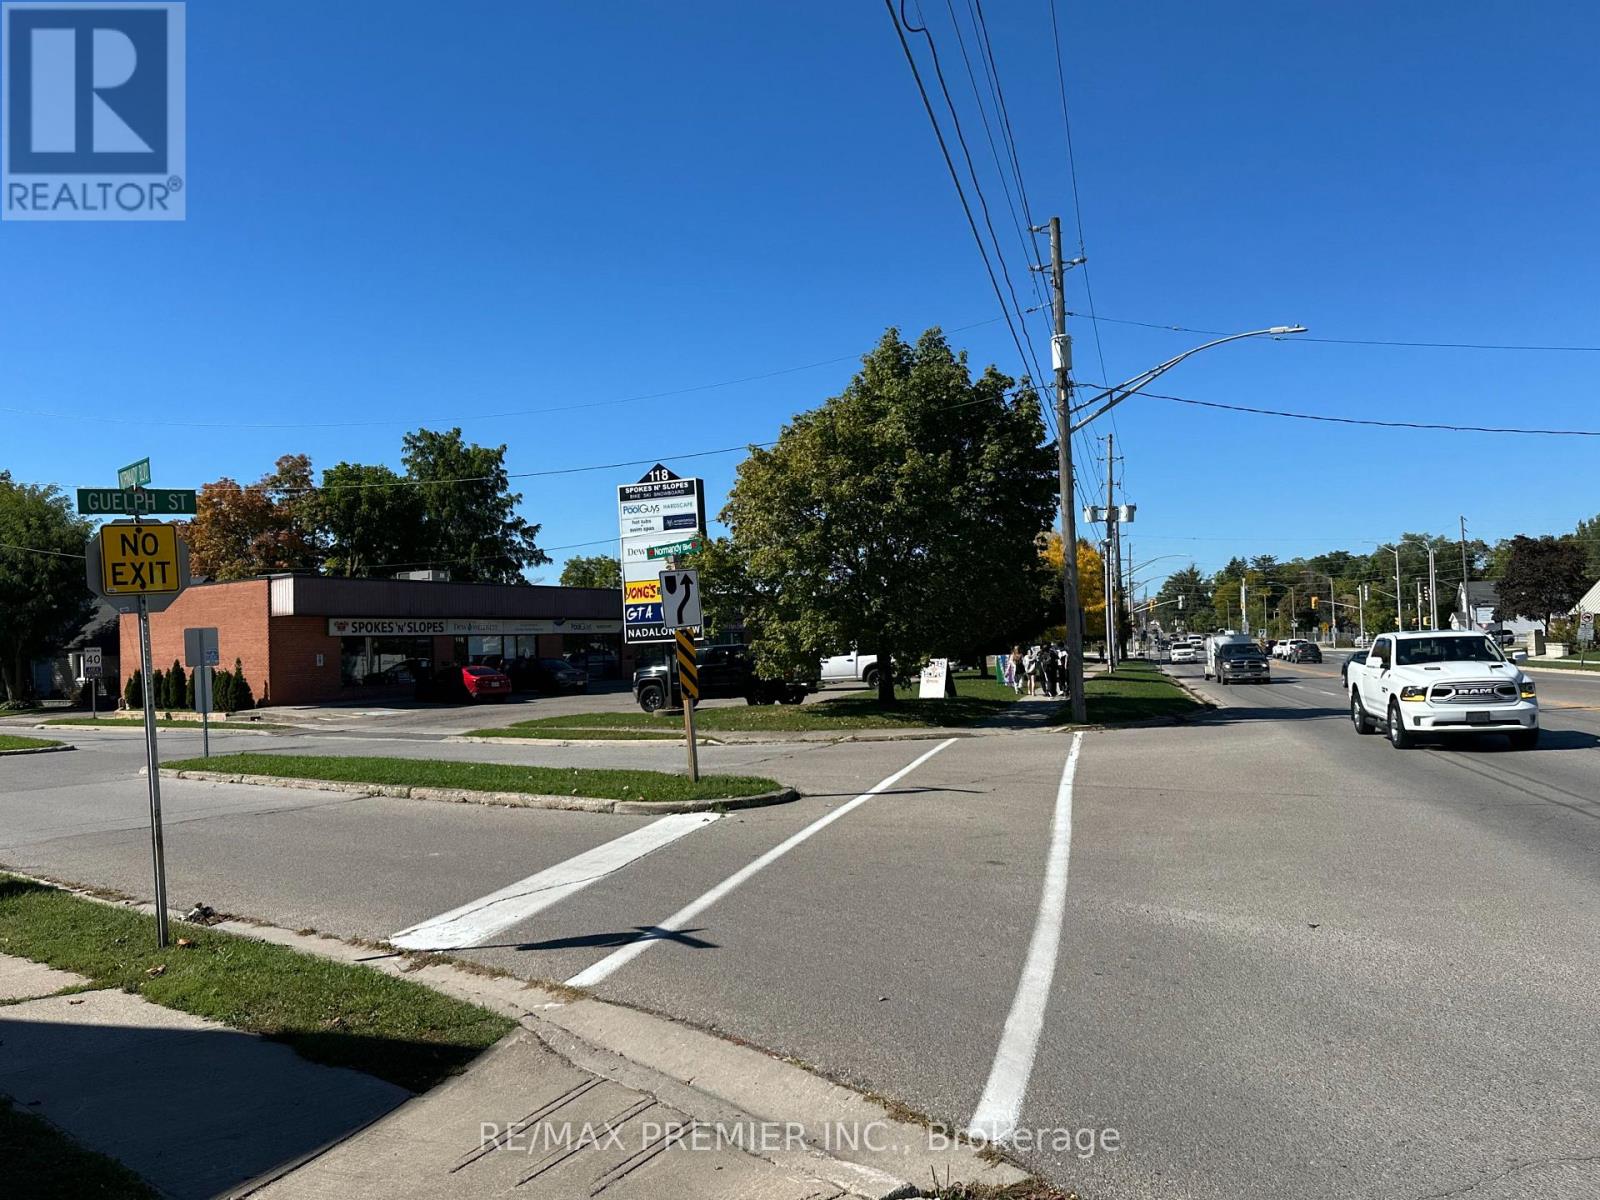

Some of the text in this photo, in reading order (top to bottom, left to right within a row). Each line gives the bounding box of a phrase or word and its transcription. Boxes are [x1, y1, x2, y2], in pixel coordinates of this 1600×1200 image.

[649, 469, 669, 482] 118
[625, 485, 653, 494] SPOKES
[662, 481, 689, 490] SLOPES
[653, 489, 685, 497] SNOWBOARD
[87, 492, 188, 510] GUELPH ST
[120, 533, 159, 557] NO
[654, 543, 682, 556] Normandy
[111, 561, 170, 586] EXIT
[626, 604, 653, 621] GTA
[351, 621, 394, 634] SPOKES
[407, 621, 445, 633] SLOPES
[628, 626, 676, 638] NADALON
[86, 654, 101, 665] 40
[1458, 687, 1493, 695] RAM
